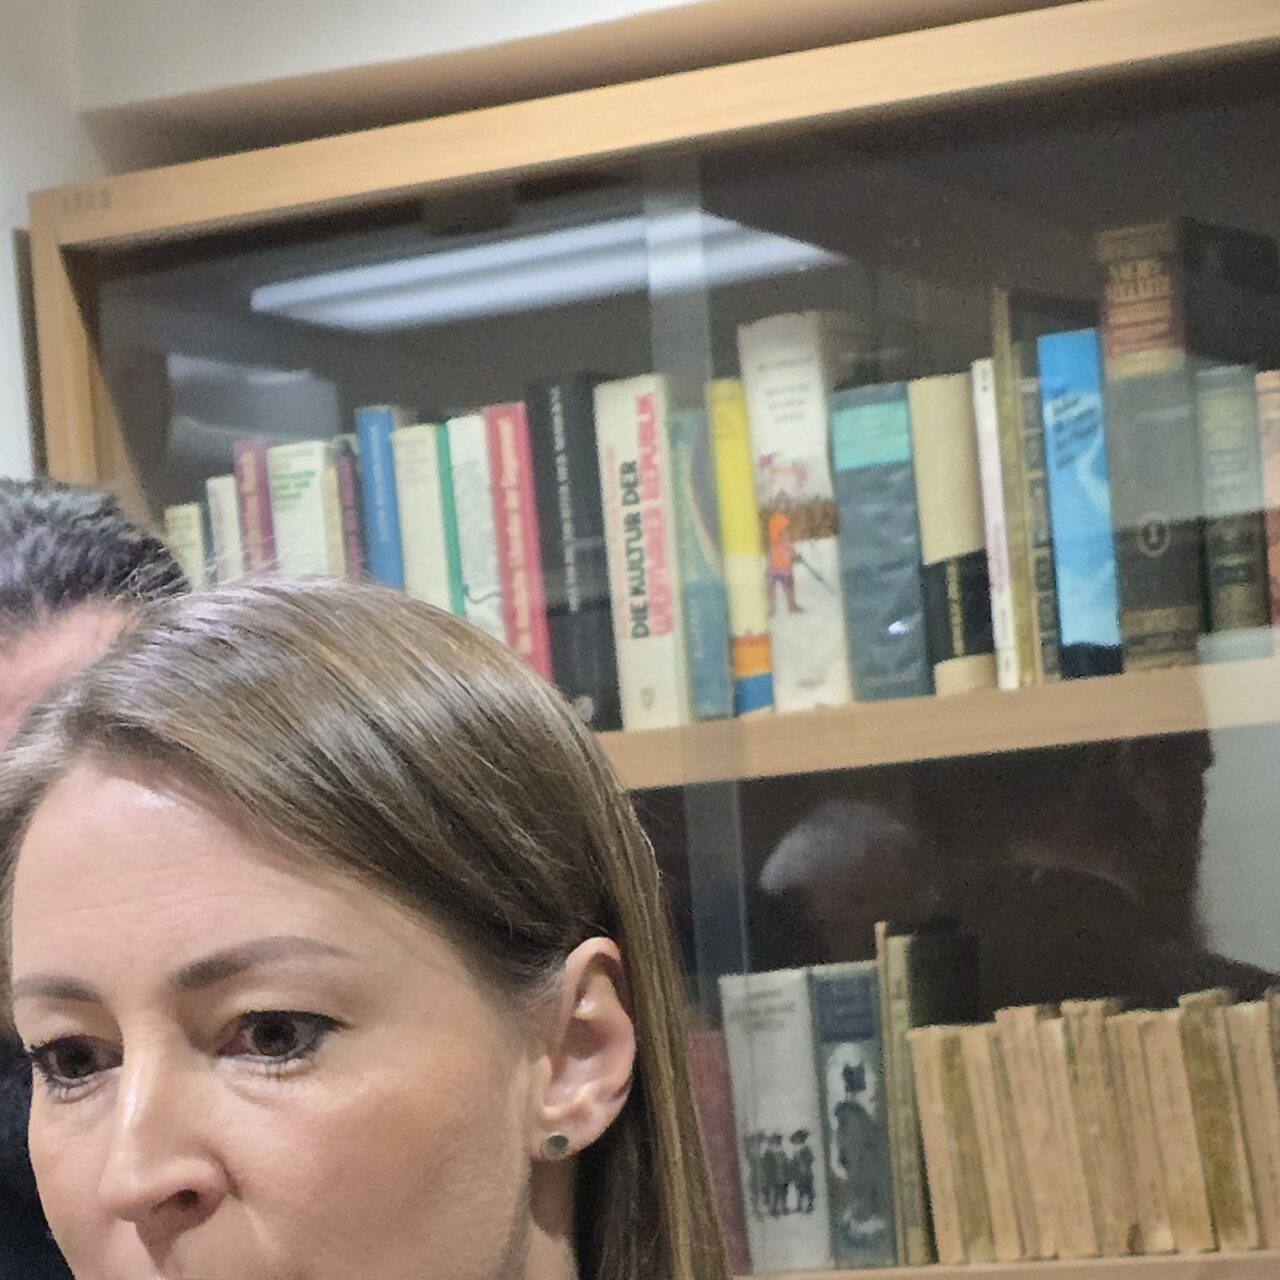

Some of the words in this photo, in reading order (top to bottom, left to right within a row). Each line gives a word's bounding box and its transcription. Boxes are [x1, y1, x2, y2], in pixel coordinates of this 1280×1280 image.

[619, 459, 640, 507] DER
[623, 511, 646, 598] KULTUR
[630, 599, 651, 640] DIE
